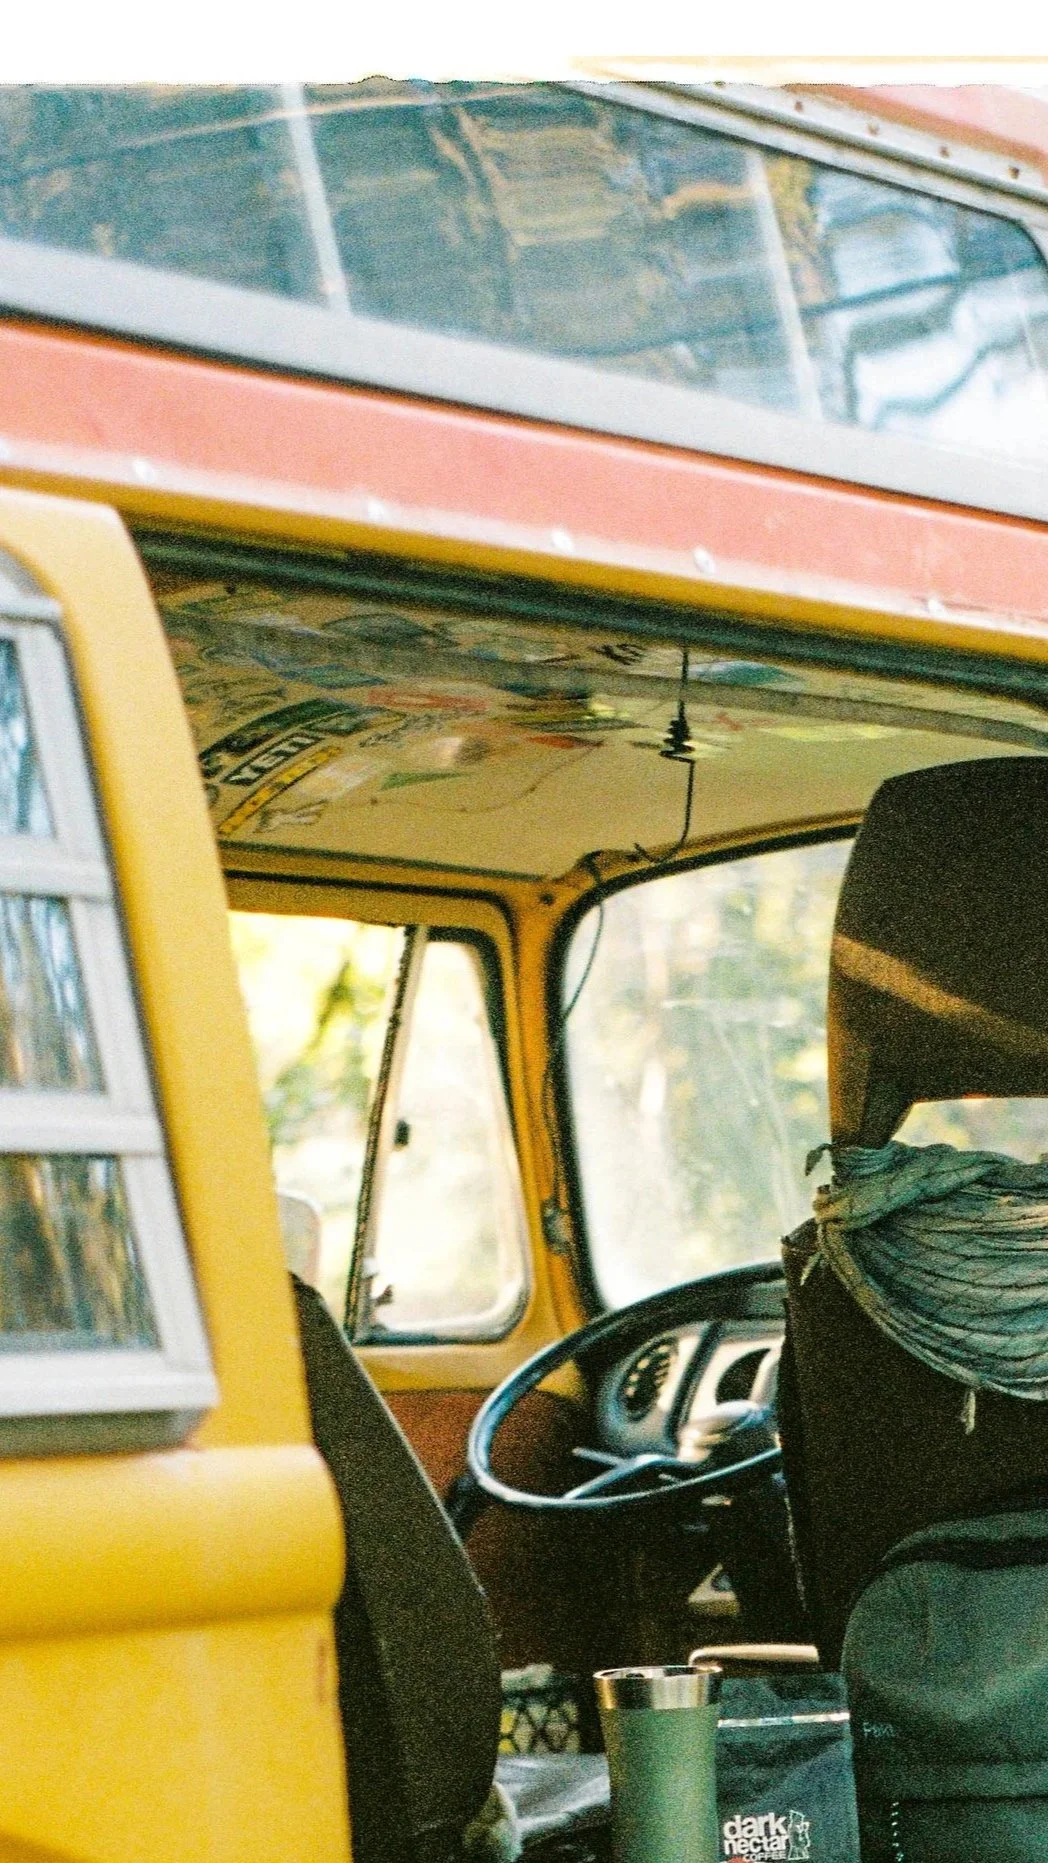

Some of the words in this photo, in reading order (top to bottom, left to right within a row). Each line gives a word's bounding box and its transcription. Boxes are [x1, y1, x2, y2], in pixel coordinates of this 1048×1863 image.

[228, 736, 315, 782] YETI
[723, 1812, 788, 1839] dark
[723, 1834, 789, 1855] nectar
[743, 1850, 787, 1862] COFFEE
